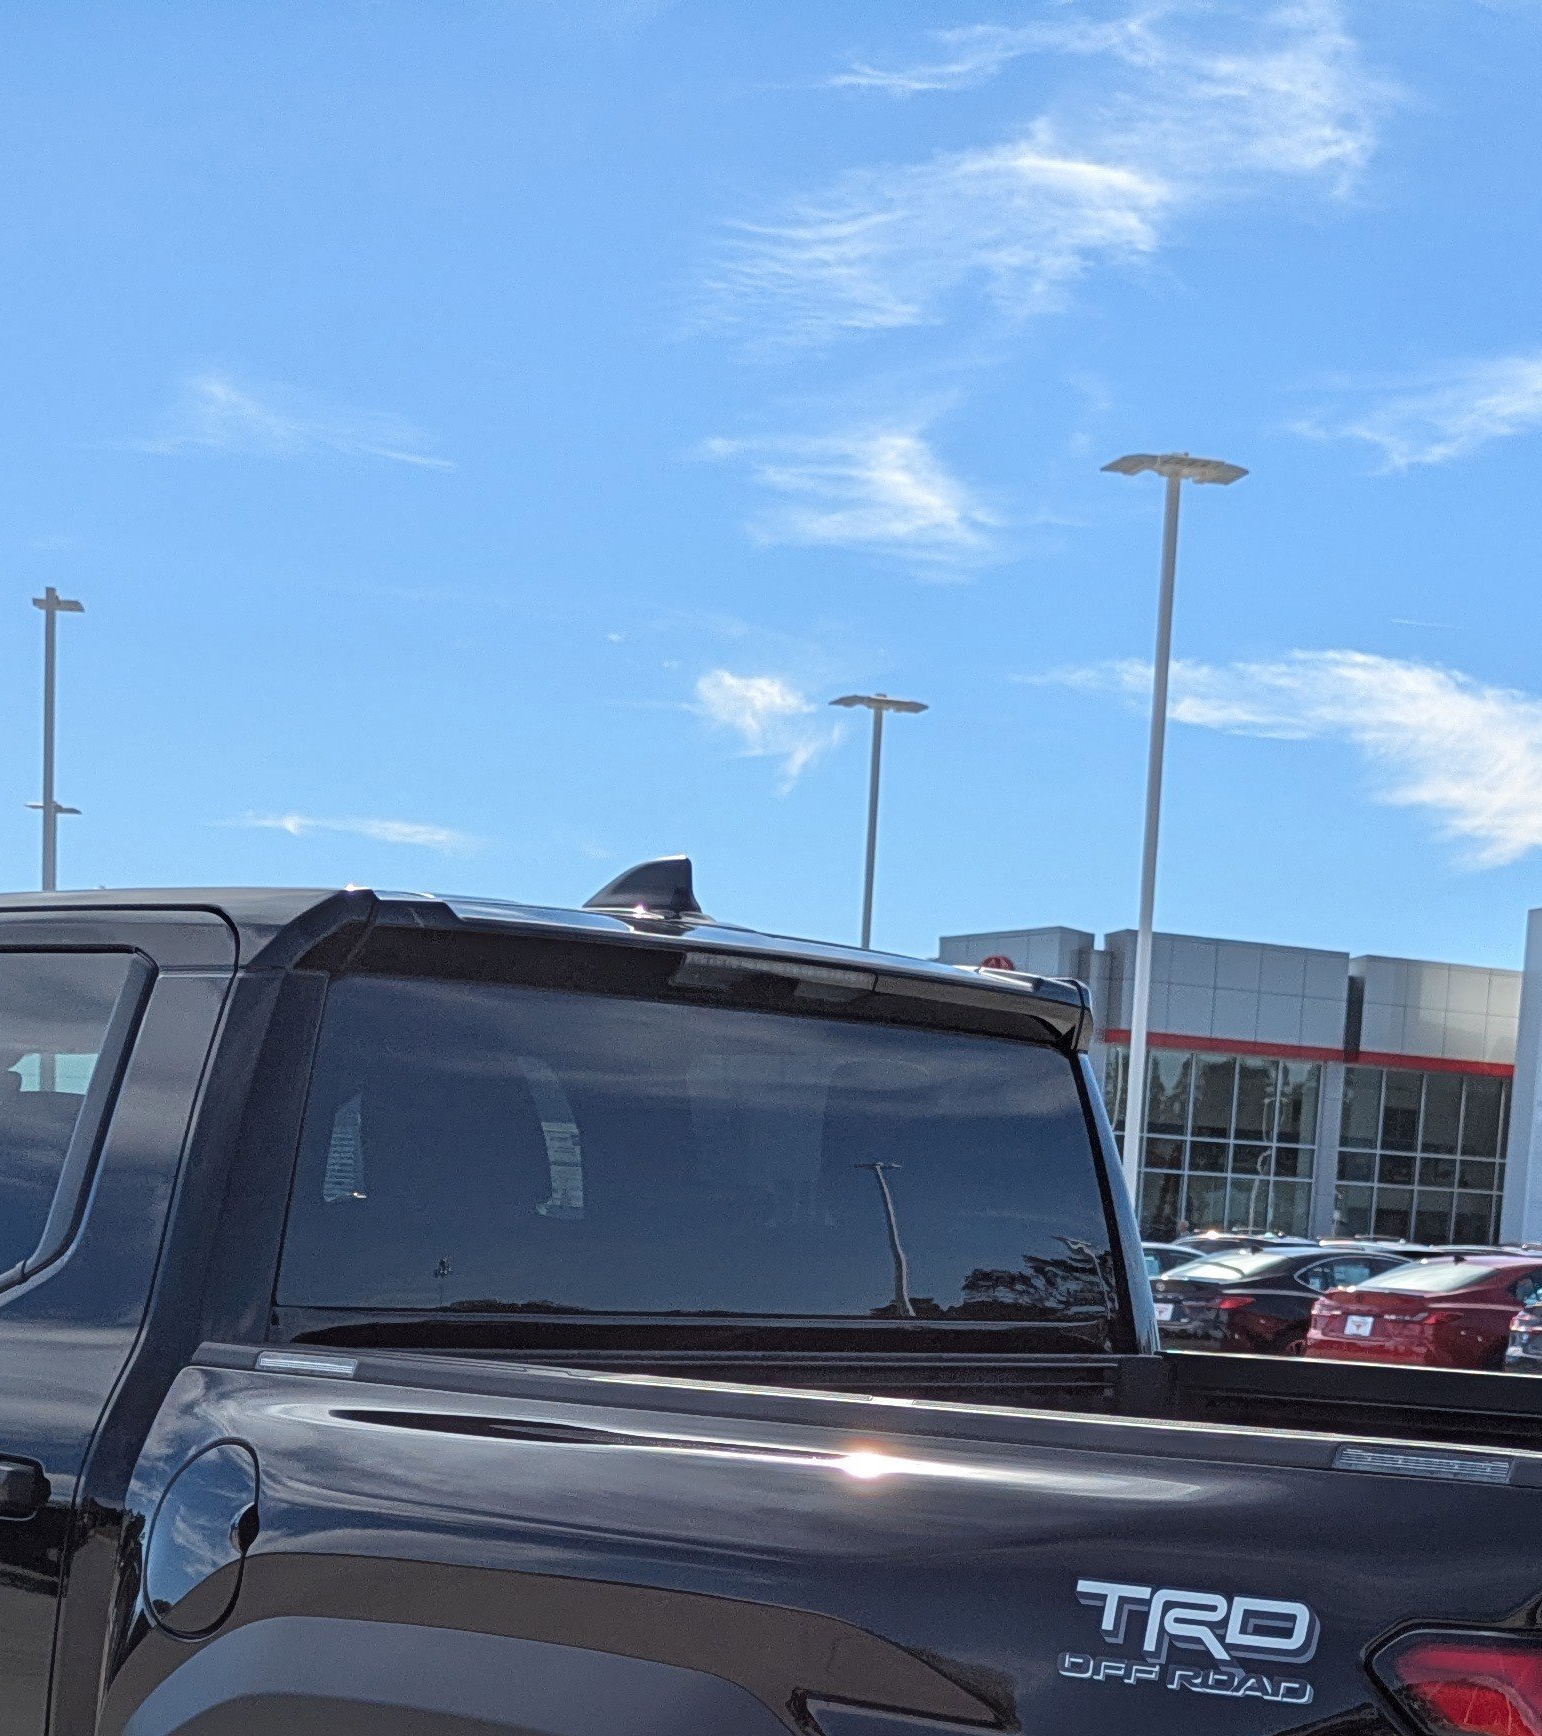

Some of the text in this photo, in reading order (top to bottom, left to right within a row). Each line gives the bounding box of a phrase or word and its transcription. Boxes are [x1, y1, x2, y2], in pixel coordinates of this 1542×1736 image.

[1075, 1578, 1319, 1664] TRD
[1058, 1652, 1314, 1704] OFF ROAD
